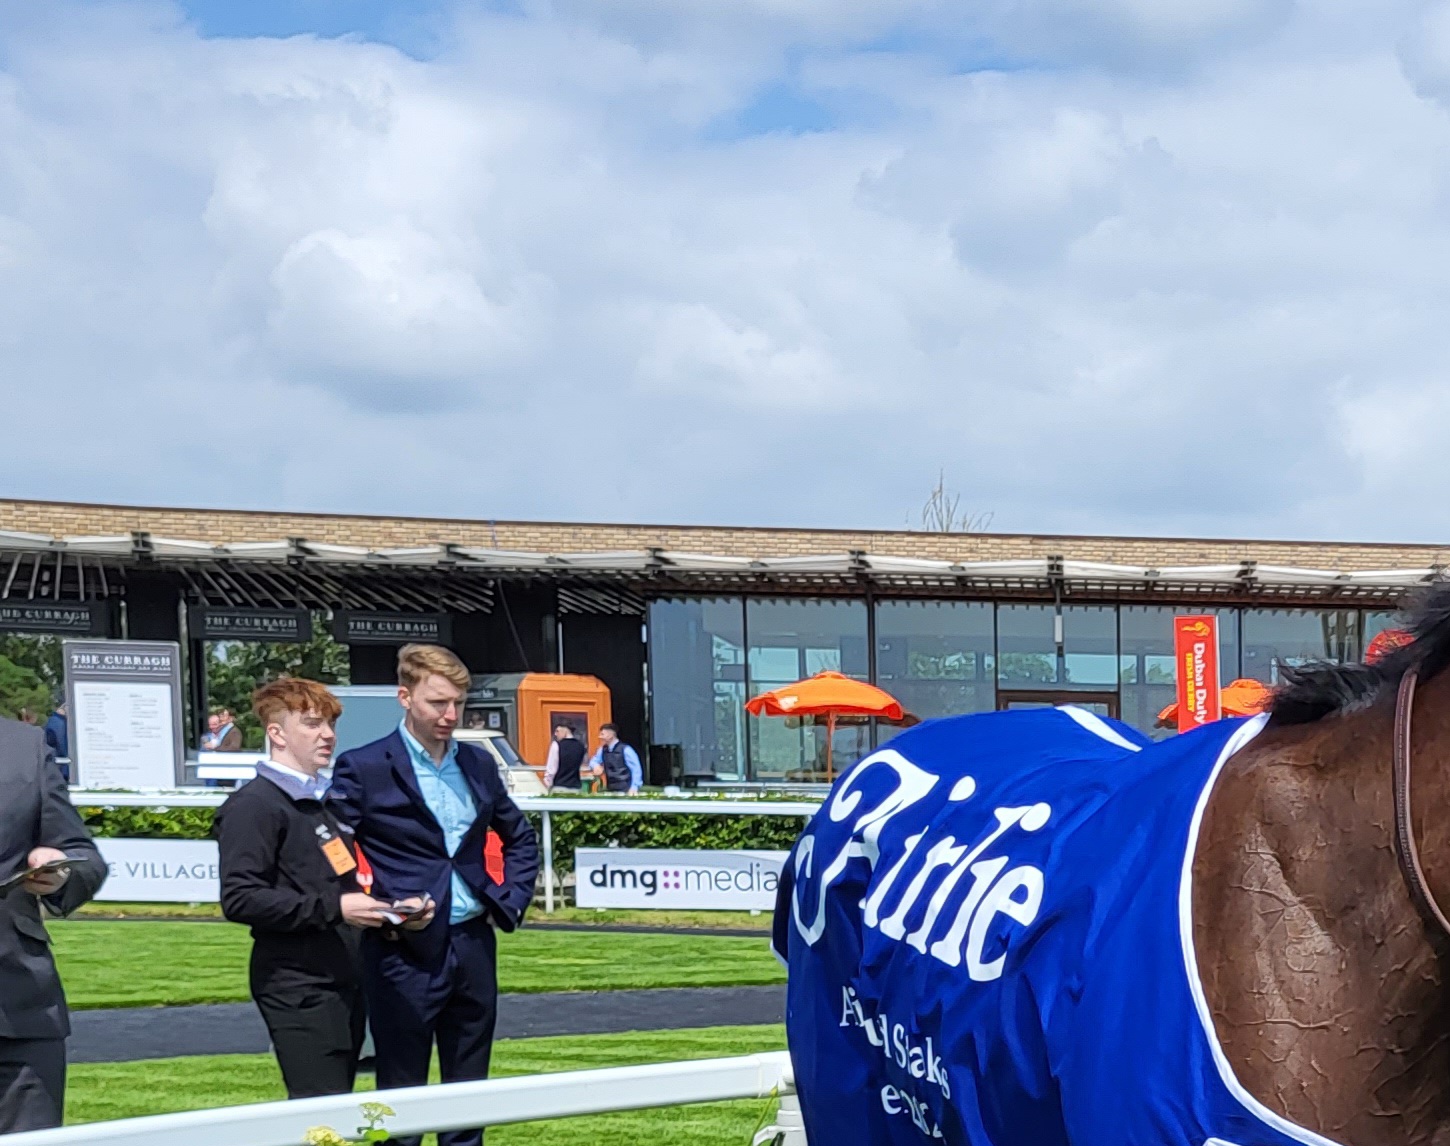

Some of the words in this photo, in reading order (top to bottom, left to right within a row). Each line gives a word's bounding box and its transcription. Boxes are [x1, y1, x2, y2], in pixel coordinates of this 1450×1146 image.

[205, 616, 232, 627] THE
[235, 617, 298, 628] CURRAGH
[347, 620, 374, 632] THE
[377, 621, 438, 633] CURRAGH
[71, 654, 101, 665] THE
[103, 655, 171, 667] CURRAGH
[1193, 642, 1206, 687] Dubai
[1194, 688, 1208, 724] Duty
[125, 861, 218, 880] VILLAGE
